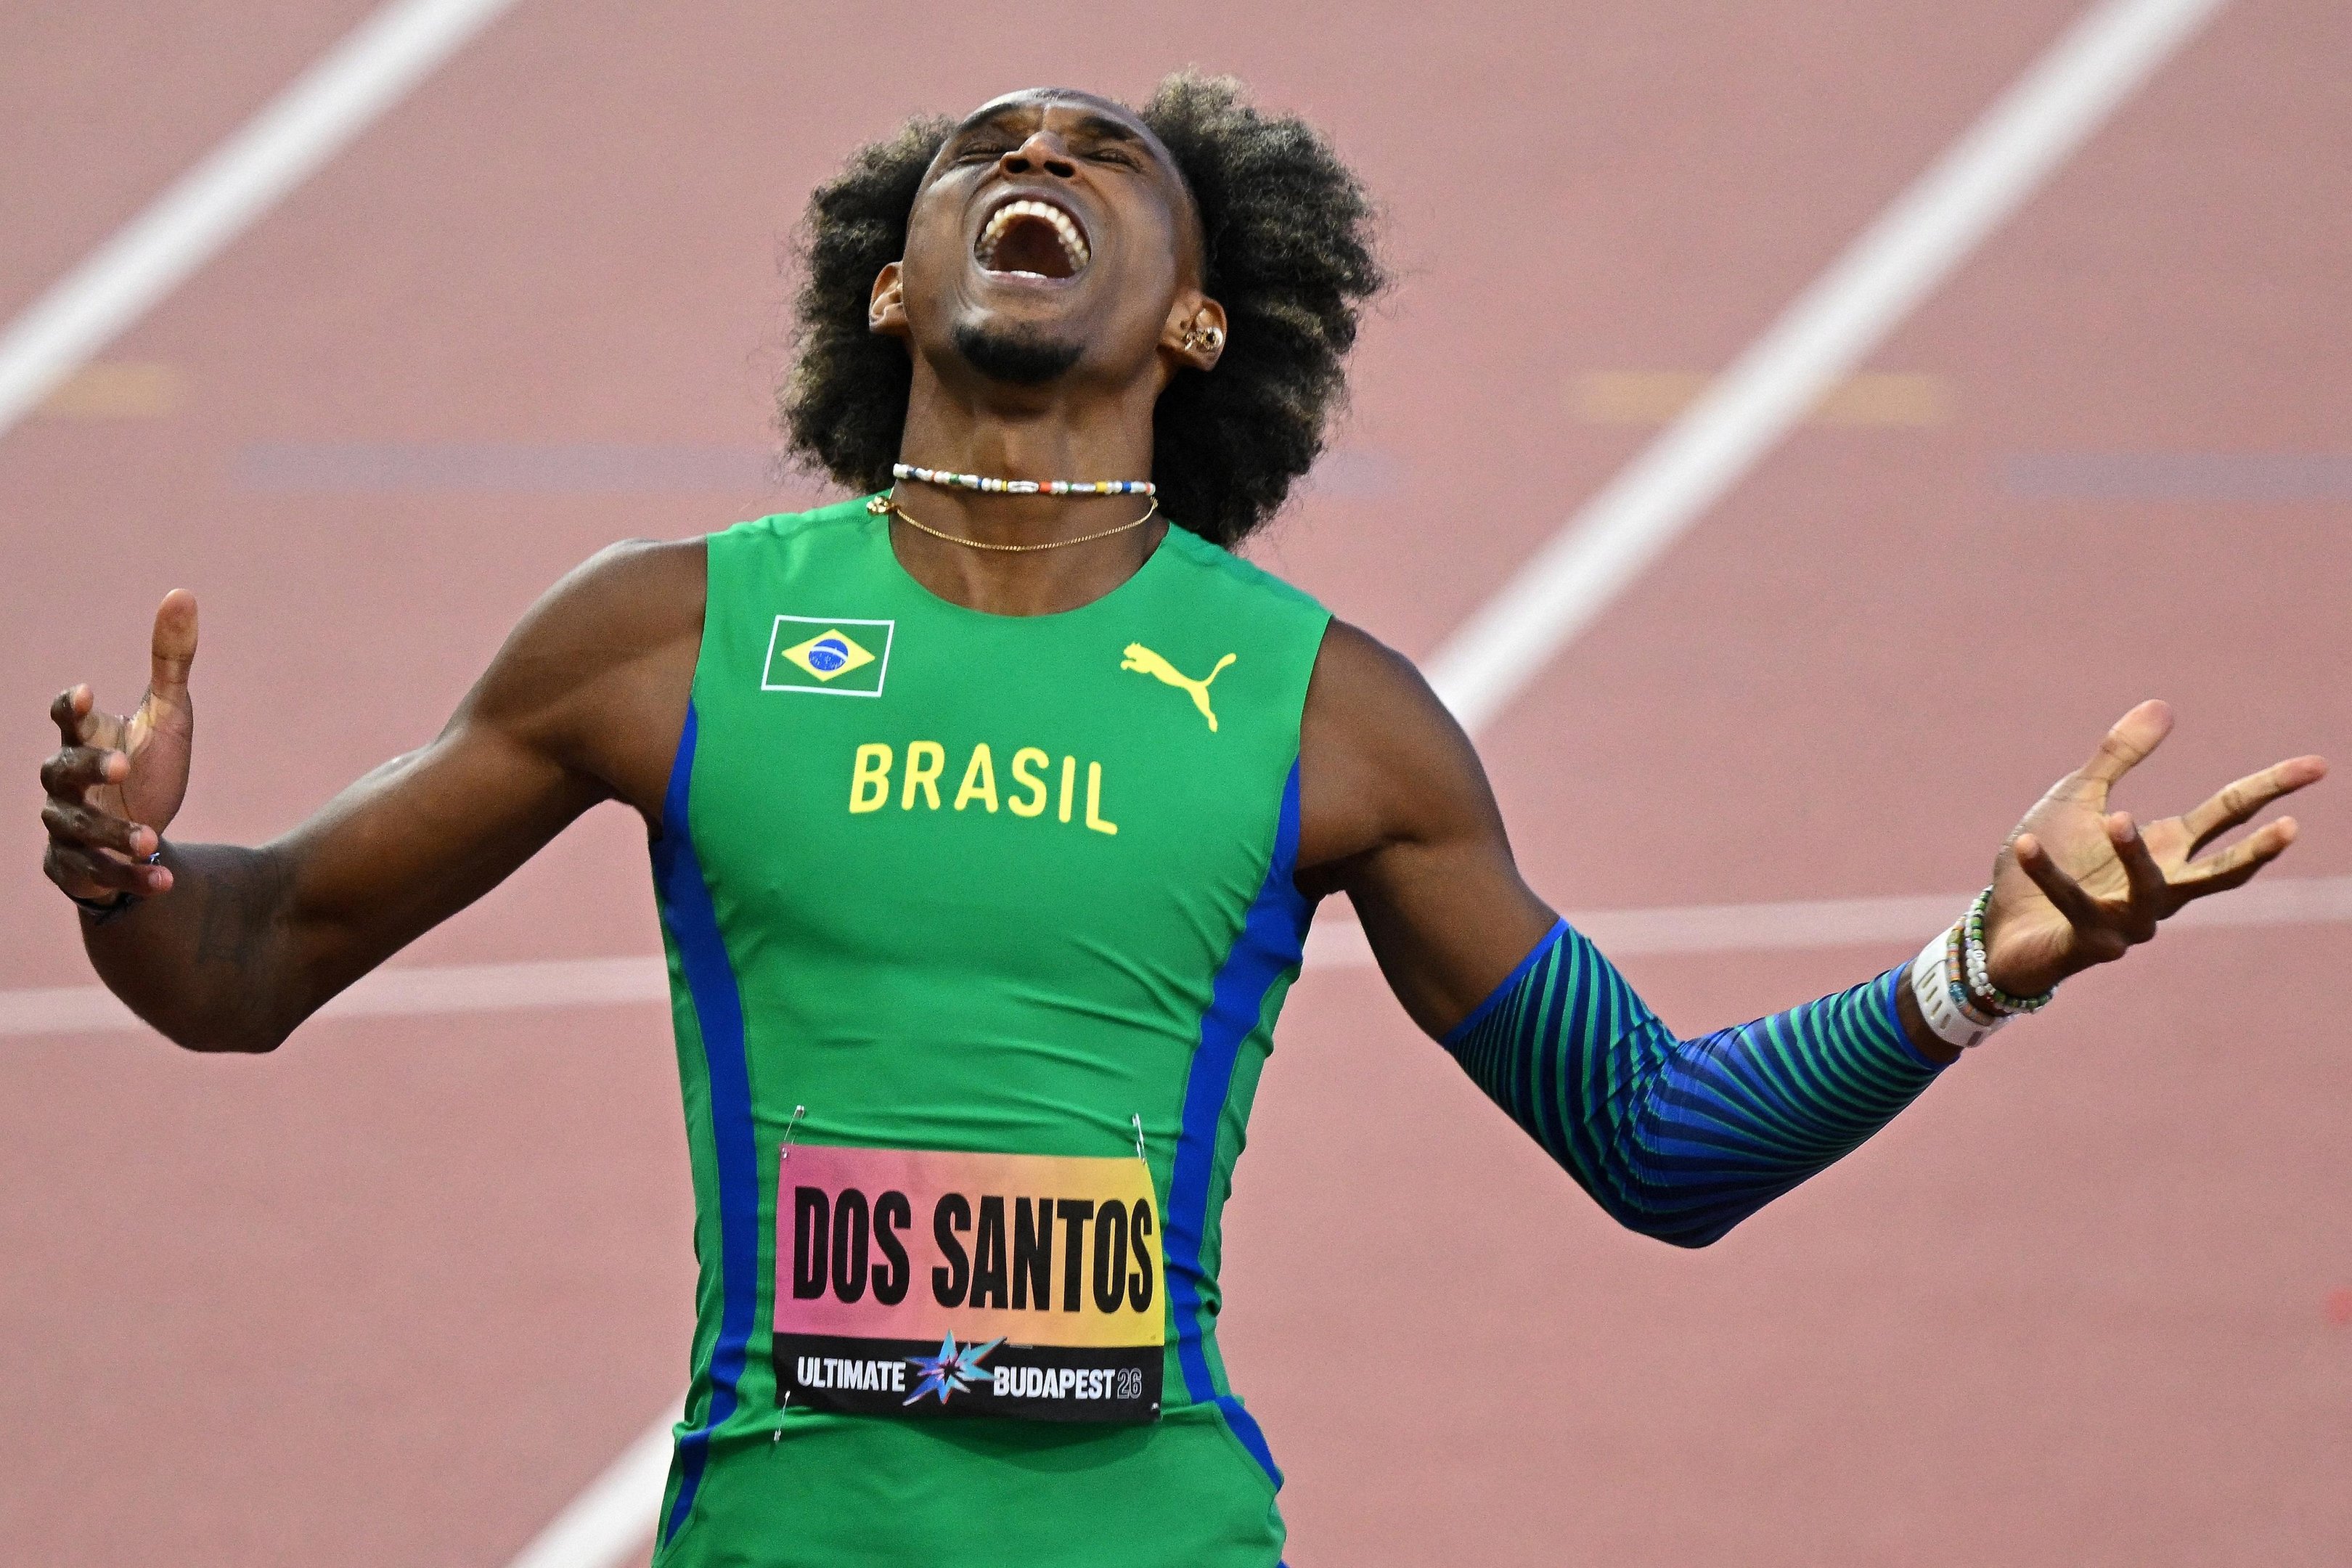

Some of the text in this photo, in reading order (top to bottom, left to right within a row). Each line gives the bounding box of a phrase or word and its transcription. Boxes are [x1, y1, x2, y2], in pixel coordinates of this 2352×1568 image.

[849, 740, 1118, 836] BRASIL
[793, 1185, 1153, 1314] DOS SANTOS
[797, 1356, 1143, 1400] ULTIMATE BUDAPEST 26
